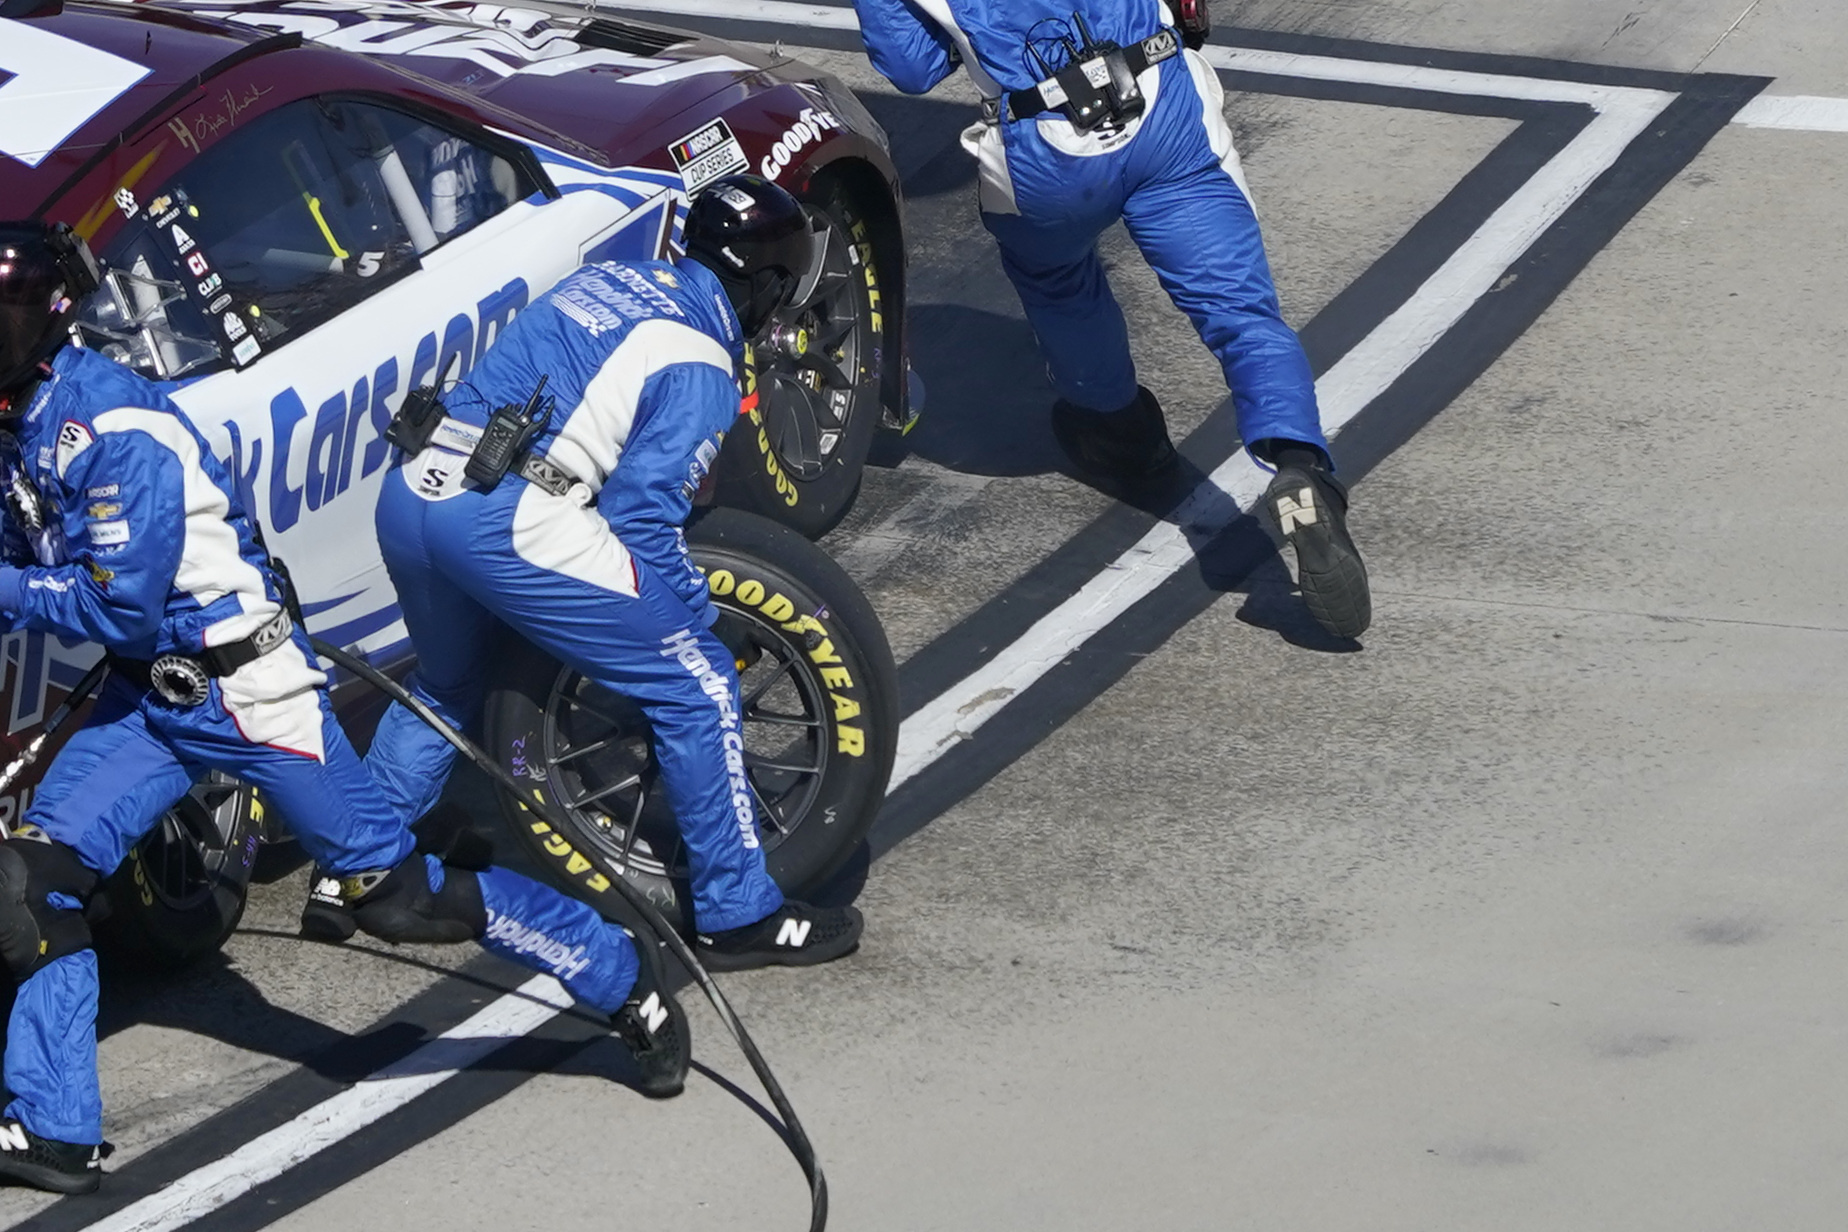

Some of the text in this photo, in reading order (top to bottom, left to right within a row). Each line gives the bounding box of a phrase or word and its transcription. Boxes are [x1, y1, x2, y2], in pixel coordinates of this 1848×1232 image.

[689, 125, 724, 155] NASCAR
[760, 107, 840, 181] GOODYE
[690, 147, 735, 183] CUP SERIES
[356, 251, 386, 278] 5
[852, 219, 884, 334] EAGLE
[695, 566, 866, 758] OODYEAR
[776, 917, 811, 947] N
